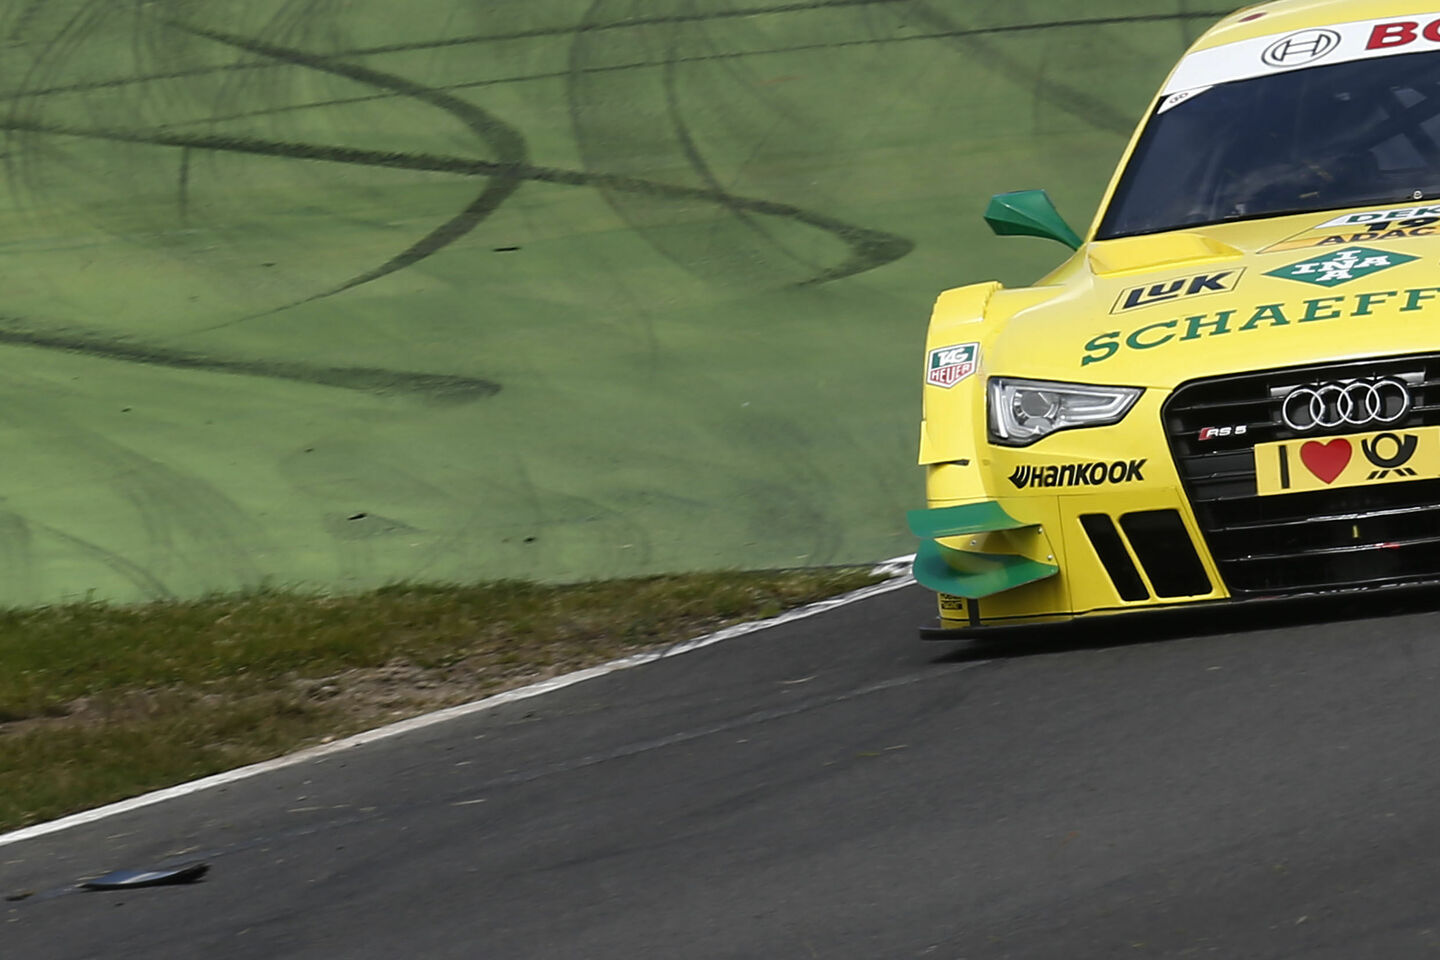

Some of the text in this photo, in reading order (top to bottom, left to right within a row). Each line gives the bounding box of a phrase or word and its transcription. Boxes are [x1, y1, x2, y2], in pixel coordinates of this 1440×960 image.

[1315, 226, 1437, 247] ADAC
[937, 347, 969, 367] TAG
[931, 363, 971, 384] HEUER
